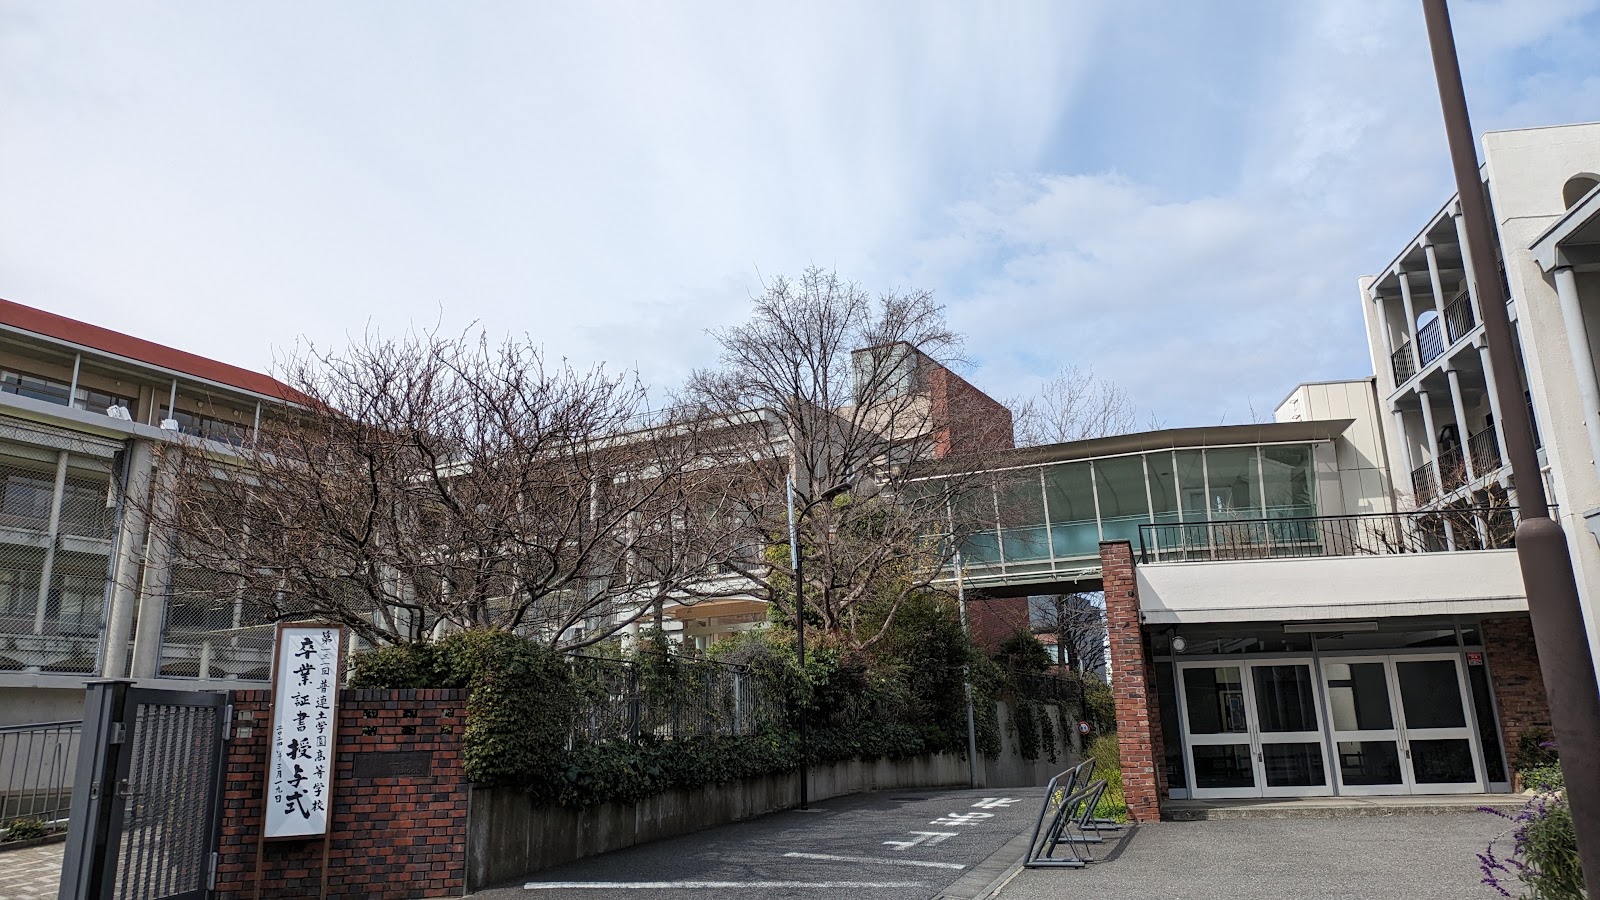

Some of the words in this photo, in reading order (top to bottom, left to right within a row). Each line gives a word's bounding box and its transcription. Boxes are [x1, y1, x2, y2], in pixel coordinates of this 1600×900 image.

[284, 637, 318, 820] 卒業証書授与式
